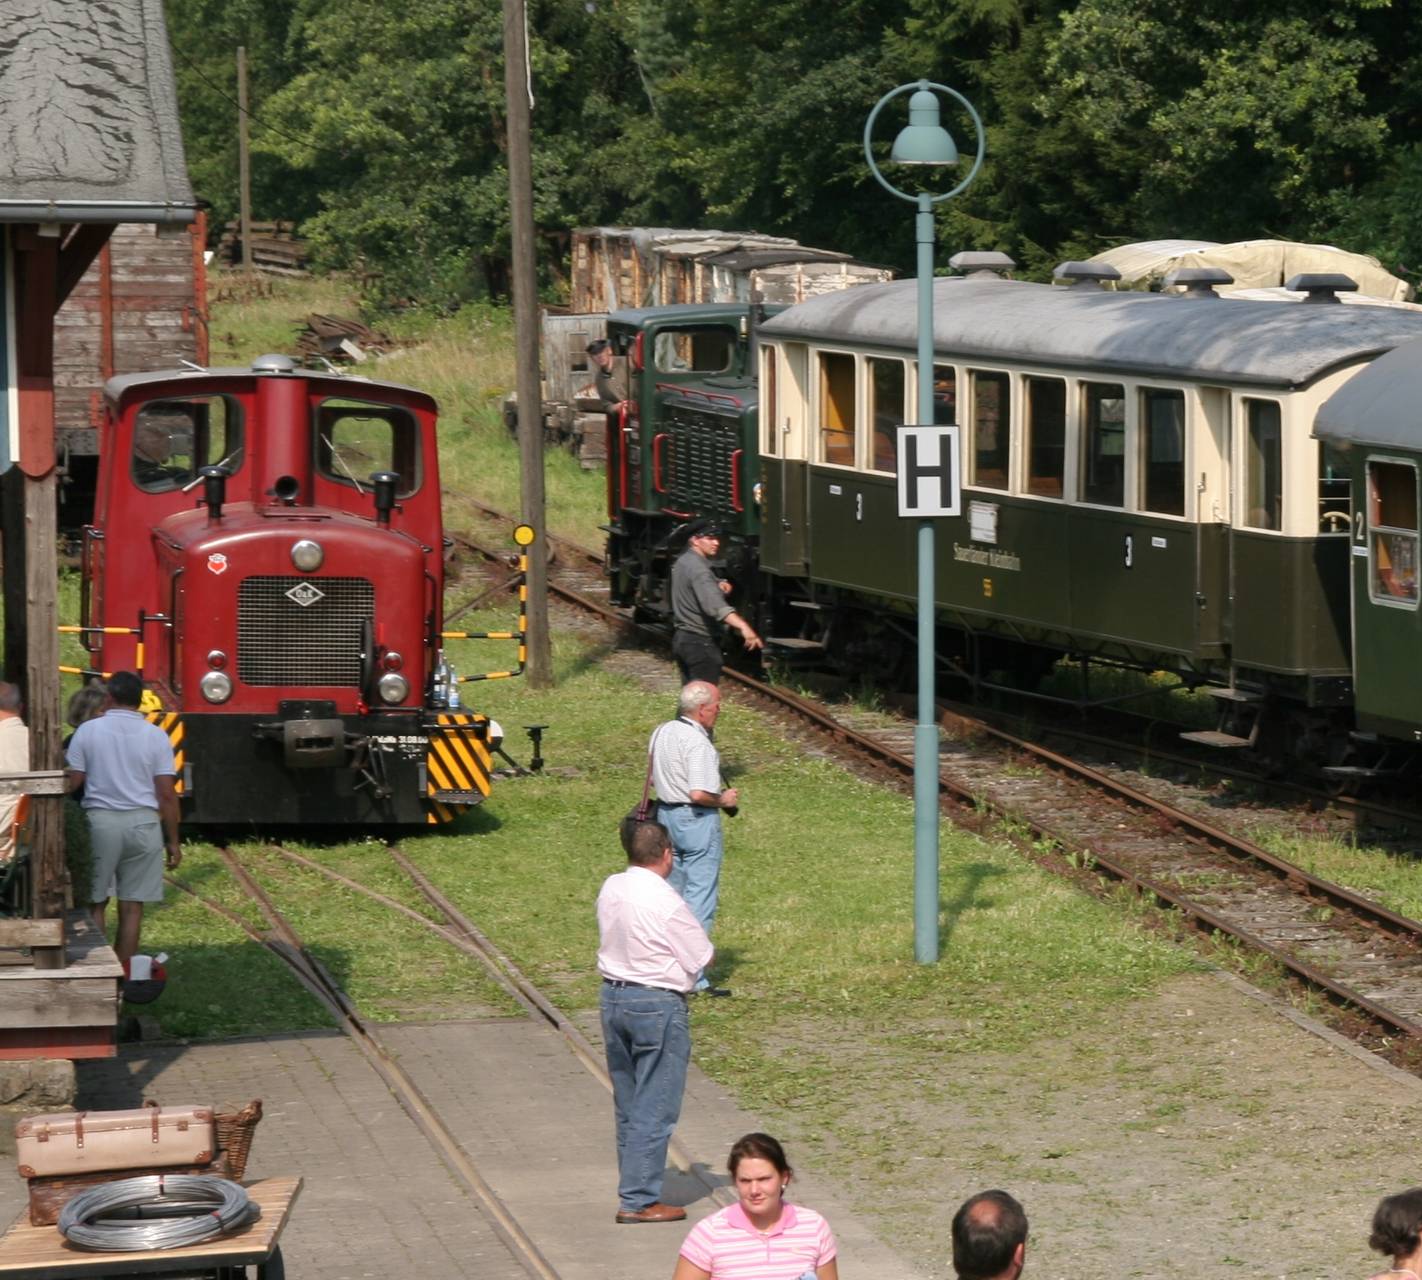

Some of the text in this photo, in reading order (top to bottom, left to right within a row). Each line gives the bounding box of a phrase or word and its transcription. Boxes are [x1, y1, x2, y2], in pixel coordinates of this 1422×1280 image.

[905, 434, 952, 509] H
[1356, 511, 1364, 540] 2
[1125, 536, 1132, 566] 3
